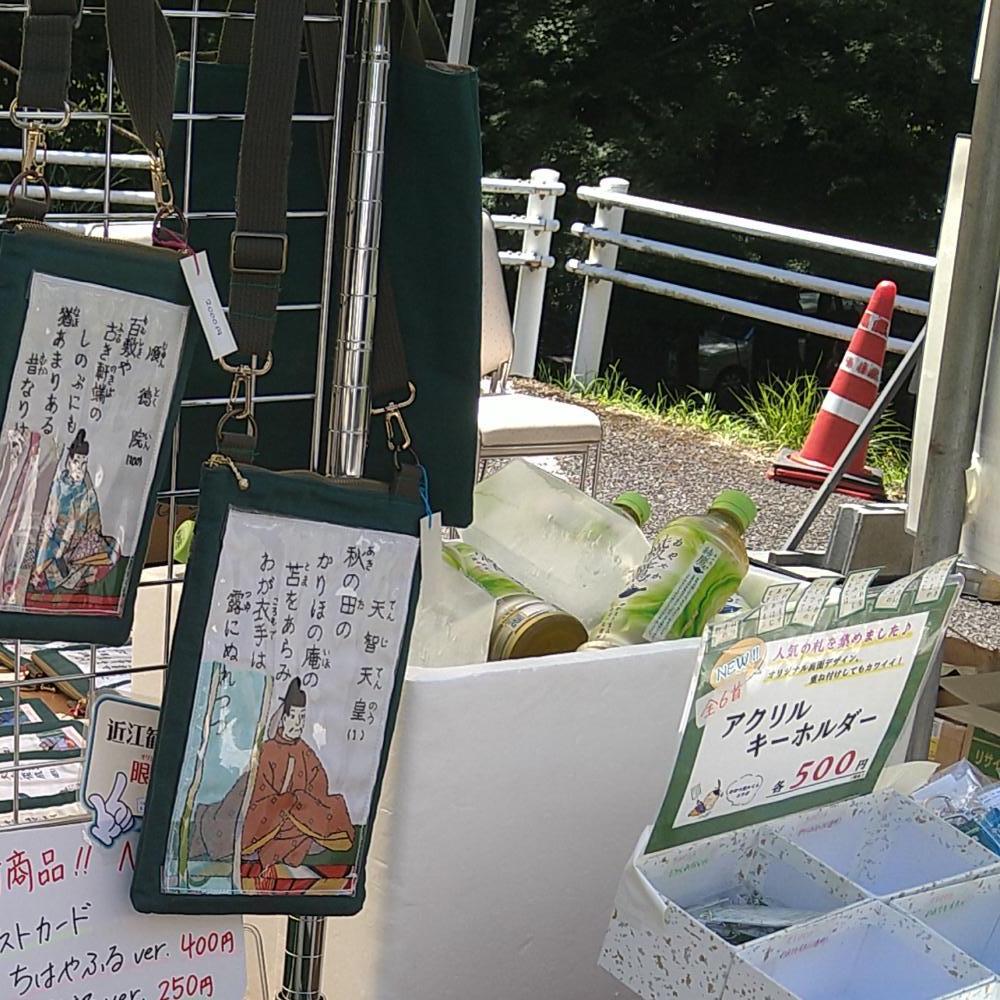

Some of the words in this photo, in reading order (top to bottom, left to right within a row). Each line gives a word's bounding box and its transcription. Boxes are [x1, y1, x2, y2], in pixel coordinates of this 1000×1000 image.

[66, 329, 91, 434] しのぶにも
[275, 562, 303, 682] 苫をあらみ
[301, 552, 334, 688] かりほの庵の
[335, 546, 366, 640] 秋の田の
[209, 590, 246, 736] 露にぬれつつ
[351, 599, 386, 723] 天智天皇
[721, 699, 813, 739] アクリル
[746, 708, 877, 758] キーホルダー
[9, 945, 125, 997] ちはやふる
[180, 930, 235, 961] 400円
